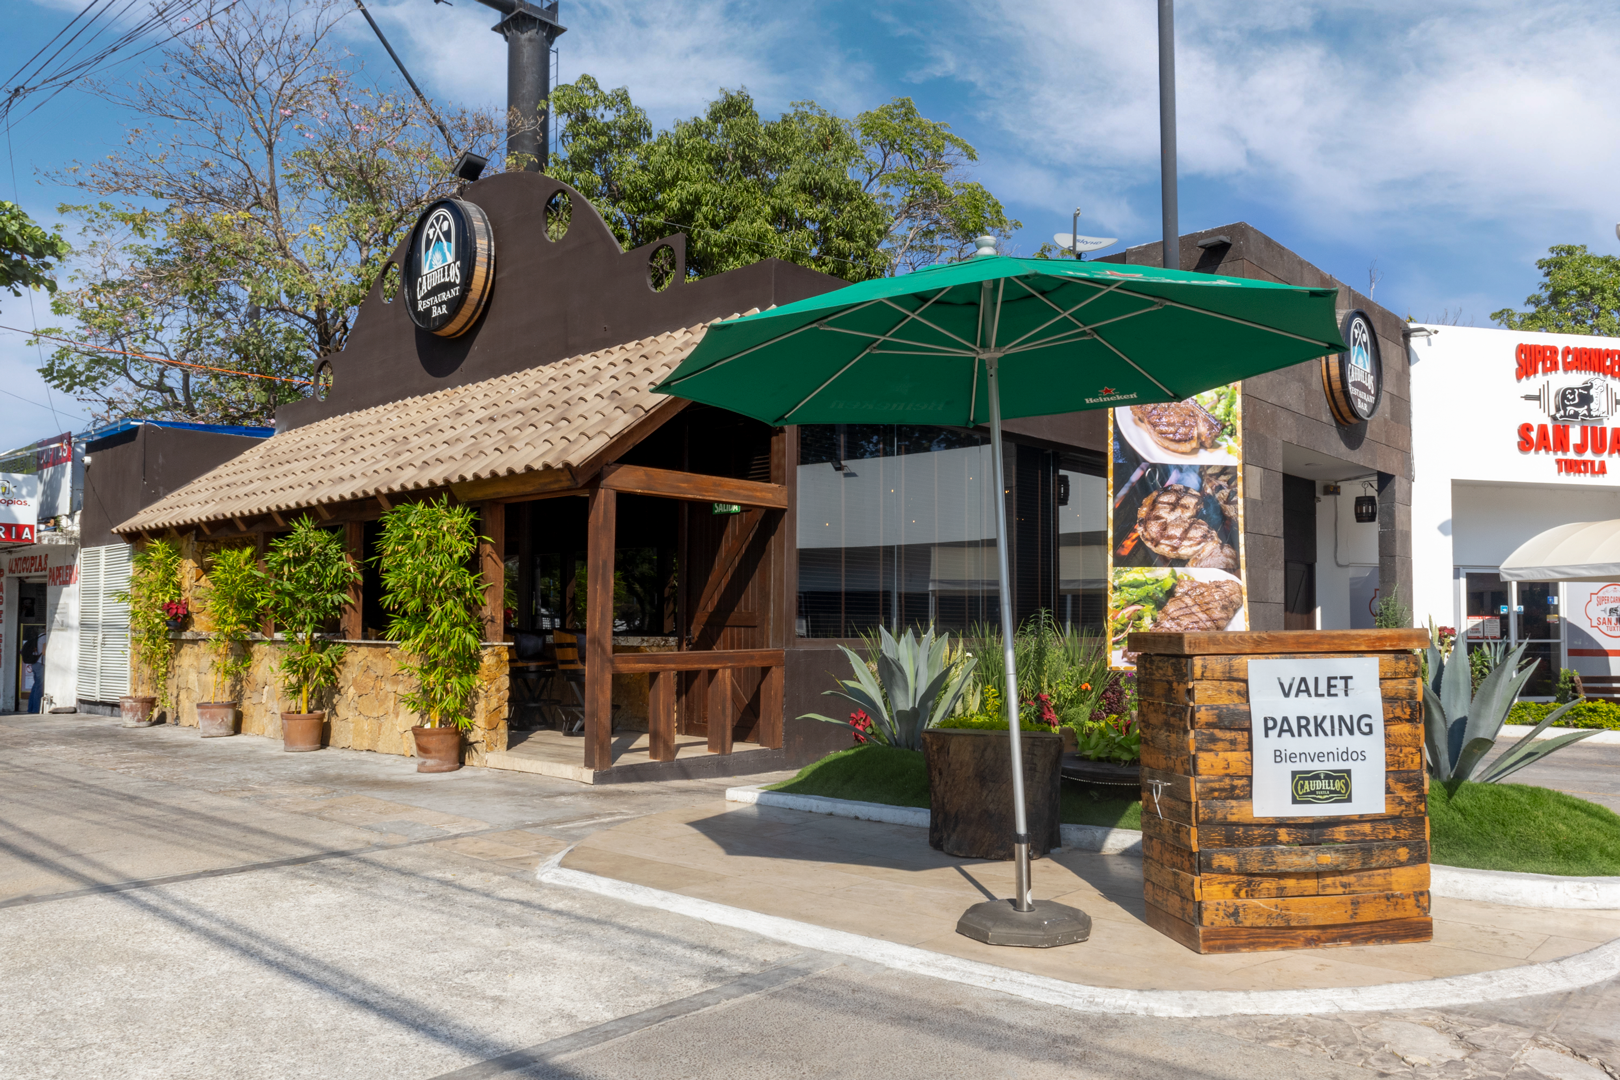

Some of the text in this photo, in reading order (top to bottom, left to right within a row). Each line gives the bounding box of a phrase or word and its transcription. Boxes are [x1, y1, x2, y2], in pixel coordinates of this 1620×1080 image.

[416, 260, 461, 300] CAUDILLOS
[417, 286, 460, 312] RESTAURANT
[431, 304, 448, 318] BAR
[1515, 343, 1560, 380] SUPER
[1084, 392, 1138, 404] Heineken
[1357, 398, 1368, 413] BAR
[1517, 422, 1620, 455] SAN JUA
[1555, 458, 1607, 475] TUXTLA
[48, 564, 78, 586] PAPELERIA
[1597, 617, 1612, 626] SAN
[1277, 676, 1353, 698] VALET
[1263, 714, 1373, 738] PARKING
[1273, 747, 1366, 764] Bienvenidos
[1297, 779, 1346, 795] CAUDILLOS
